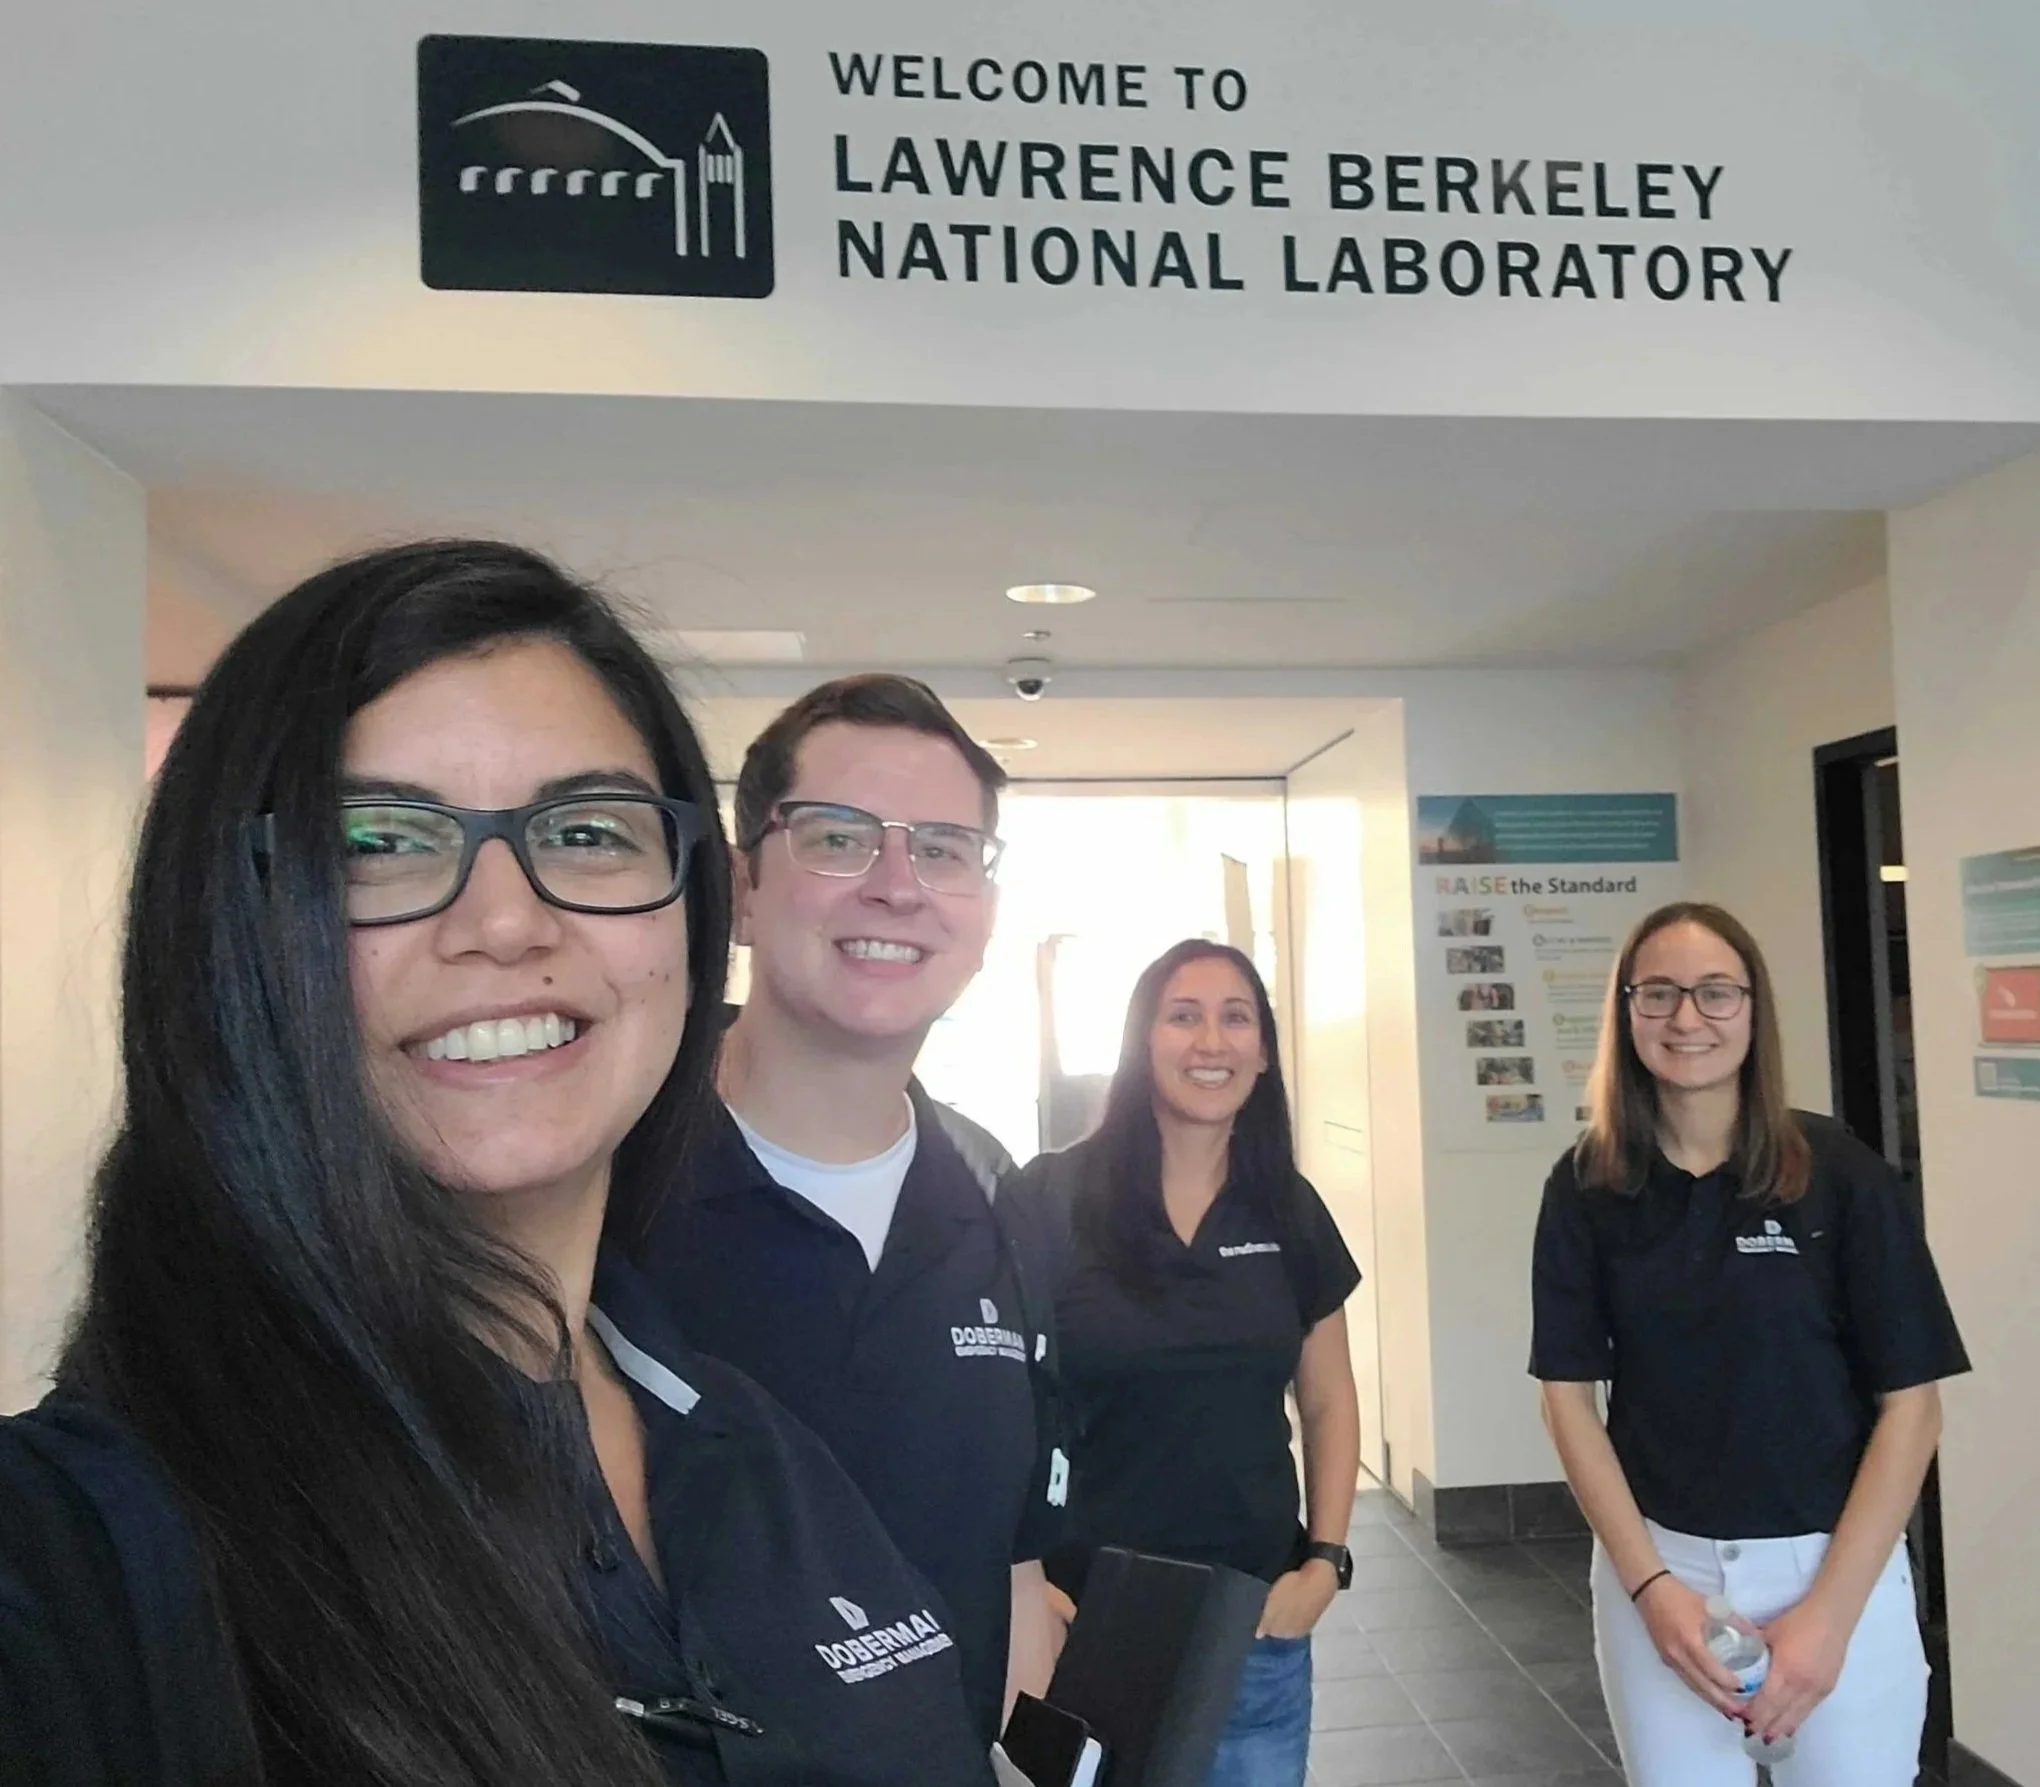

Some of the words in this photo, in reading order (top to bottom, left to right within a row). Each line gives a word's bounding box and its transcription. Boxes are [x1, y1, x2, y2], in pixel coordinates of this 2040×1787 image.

[828, 52, 1147, 109] WELCOME
[1174, 67, 1247, 112] TO
[834, 133, 1291, 209] LAWRENCE
[1327, 153, 1725, 221] BERKELEY
[837, 219, 1245, 291] NATIONAL
[1282, 234, 1793, 303] LABORATORY
[1436, 876, 1508, 895] RAISE
[1511, 878, 1543, 895] the
[1548, 877, 1637, 894] Standard
